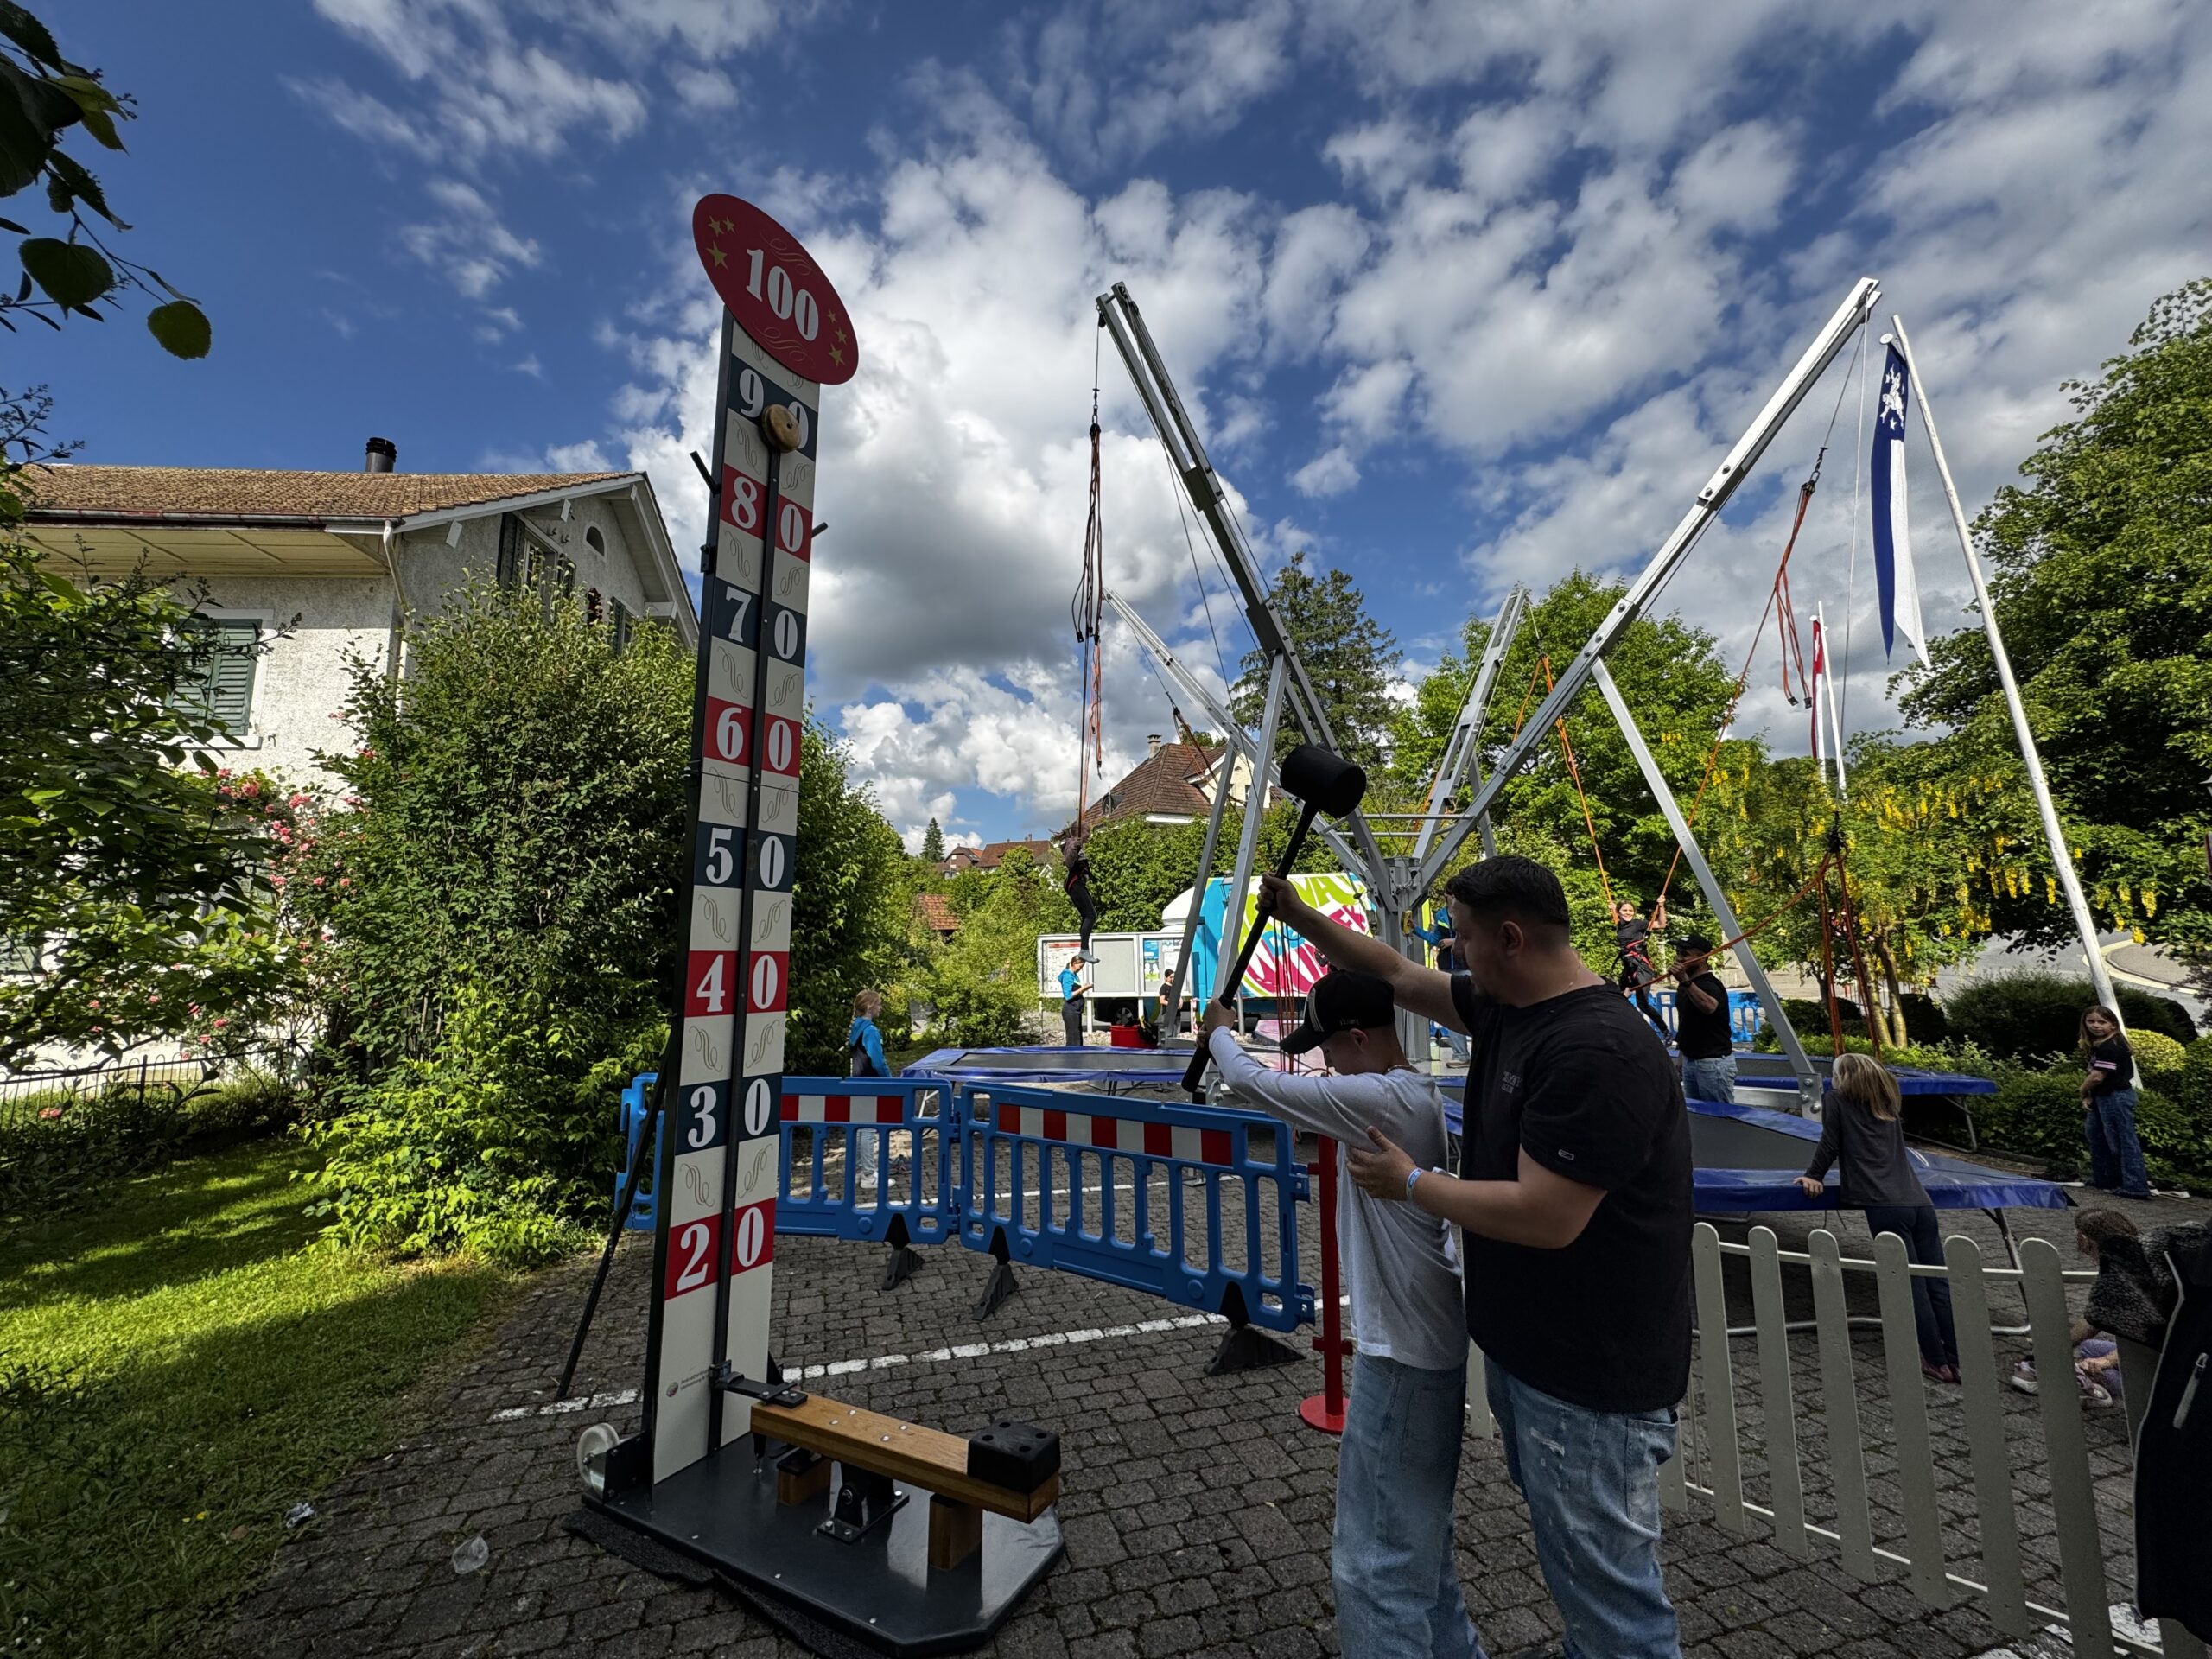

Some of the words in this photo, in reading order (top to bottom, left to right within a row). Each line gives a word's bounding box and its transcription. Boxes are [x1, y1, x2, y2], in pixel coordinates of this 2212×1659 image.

[746, 248, 819, 341] 100
[731, 476, 804, 553] 80
[726, 586, 798, 660] 70
[716, 707, 792, 772] 60
[705, 828, 785, 889] 50
[696, 954, 778, 1012] 40
[688, 1078, 771, 1148] 30
[677, 1207, 765, 1292] 20
